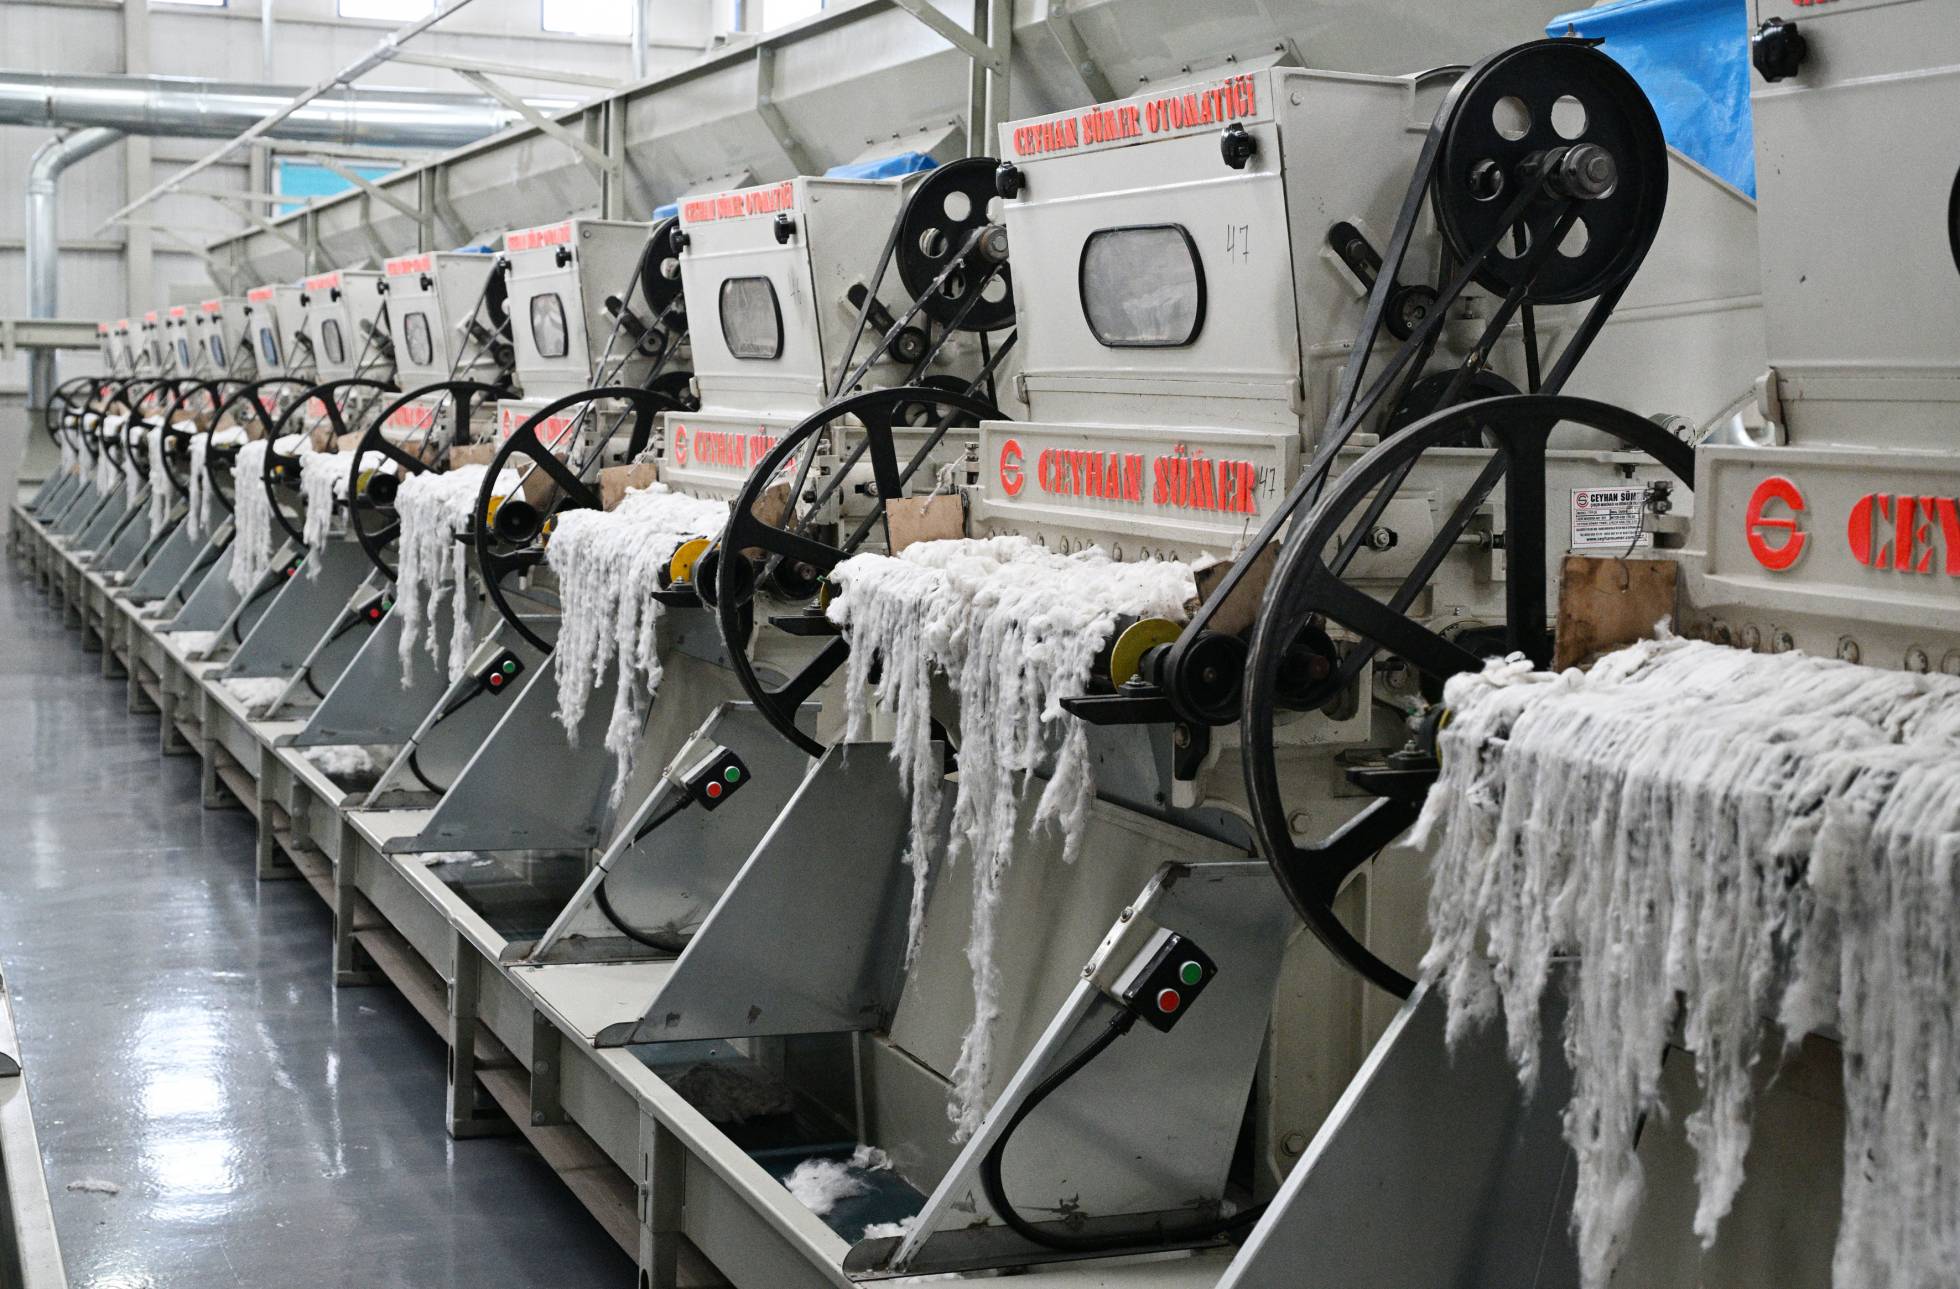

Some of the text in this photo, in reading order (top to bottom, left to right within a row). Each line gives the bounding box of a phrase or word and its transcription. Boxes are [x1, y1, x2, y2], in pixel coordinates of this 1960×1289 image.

[1013, 75, 1256, 156] CEYHAN SÜMER OTOMATİĞİ
[1226, 223, 1249, 264] 47
[694, 431, 745, 468] CEYHAN
[1038, 444, 1259, 514] CEYHAN SÜMER
[1591, 493, 1618, 502] CEYHAN
